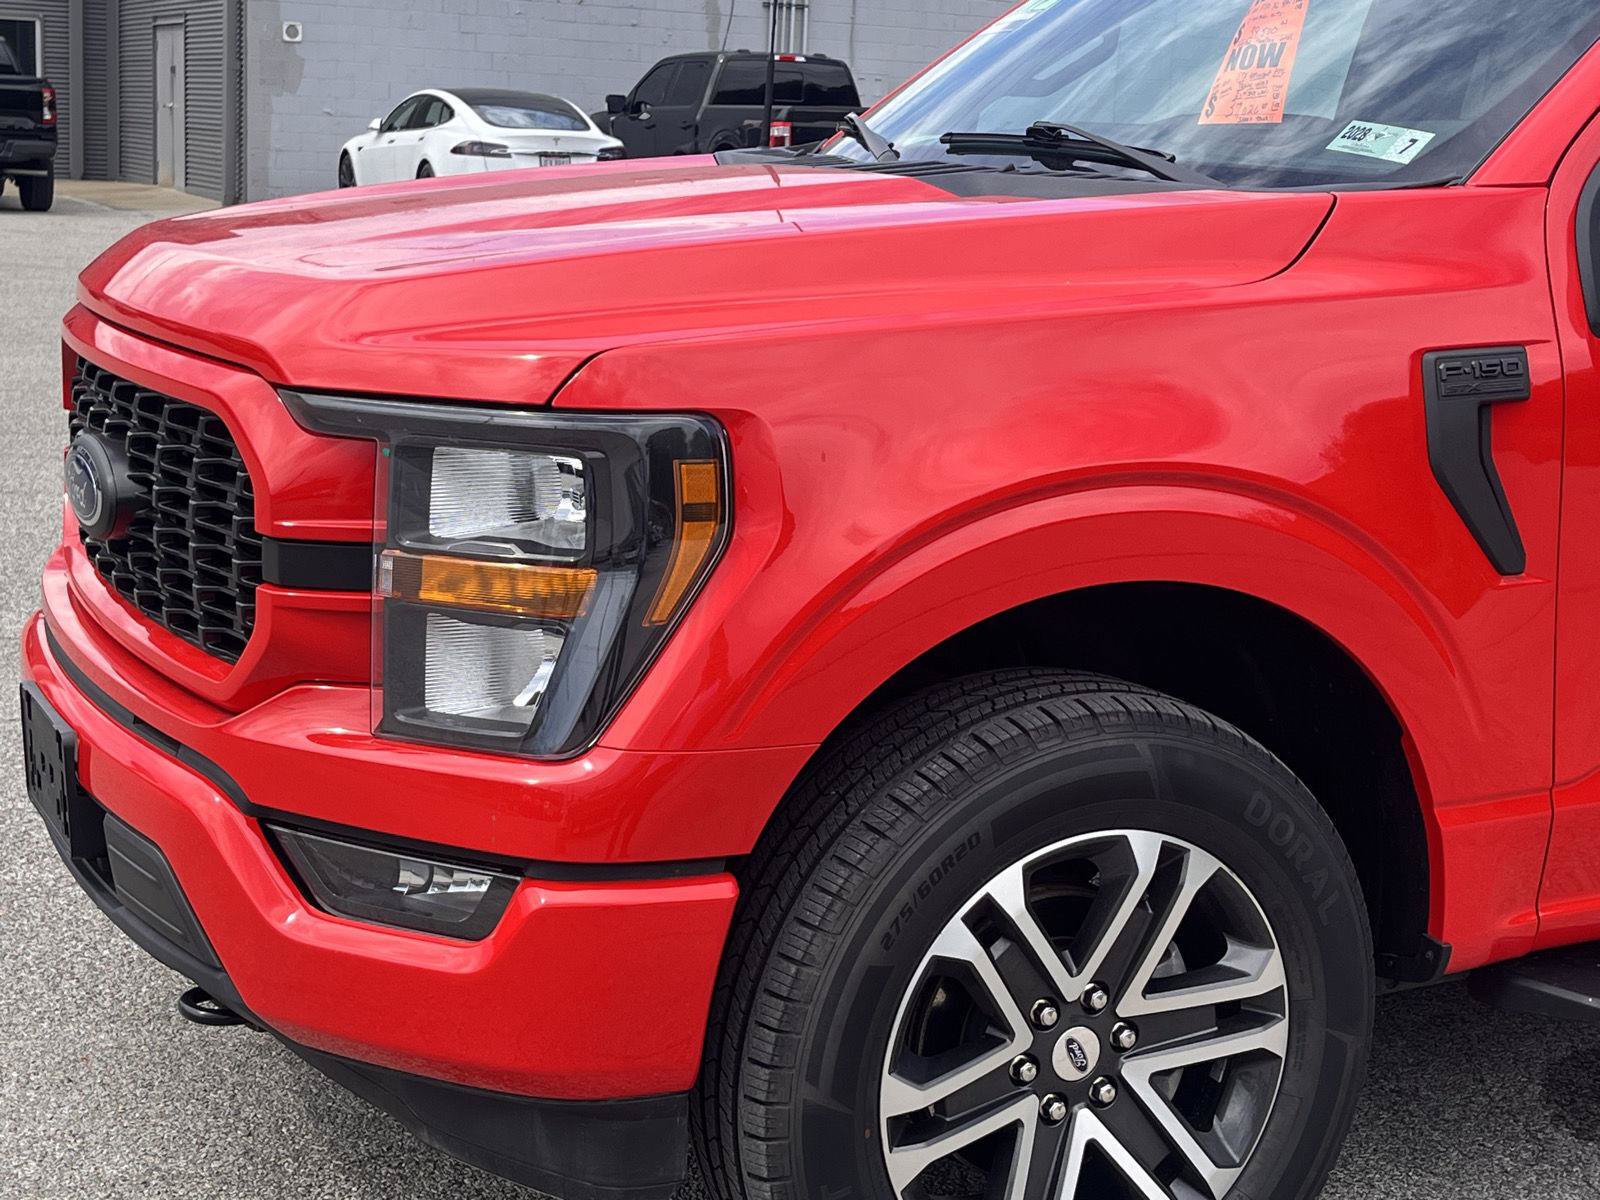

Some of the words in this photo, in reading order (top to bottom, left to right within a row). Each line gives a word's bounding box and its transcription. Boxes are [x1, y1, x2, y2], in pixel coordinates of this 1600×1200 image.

[1224, 41, 1287, 73] NOW
[1340, 125, 1373, 142] 2028
[1397, 138, 1419, 155] 7
[1438, 357, 1524, 382] F-150
[1242, 790, 1340, 927] DORAL
[880, 831, 981, 952] 275/60R20
